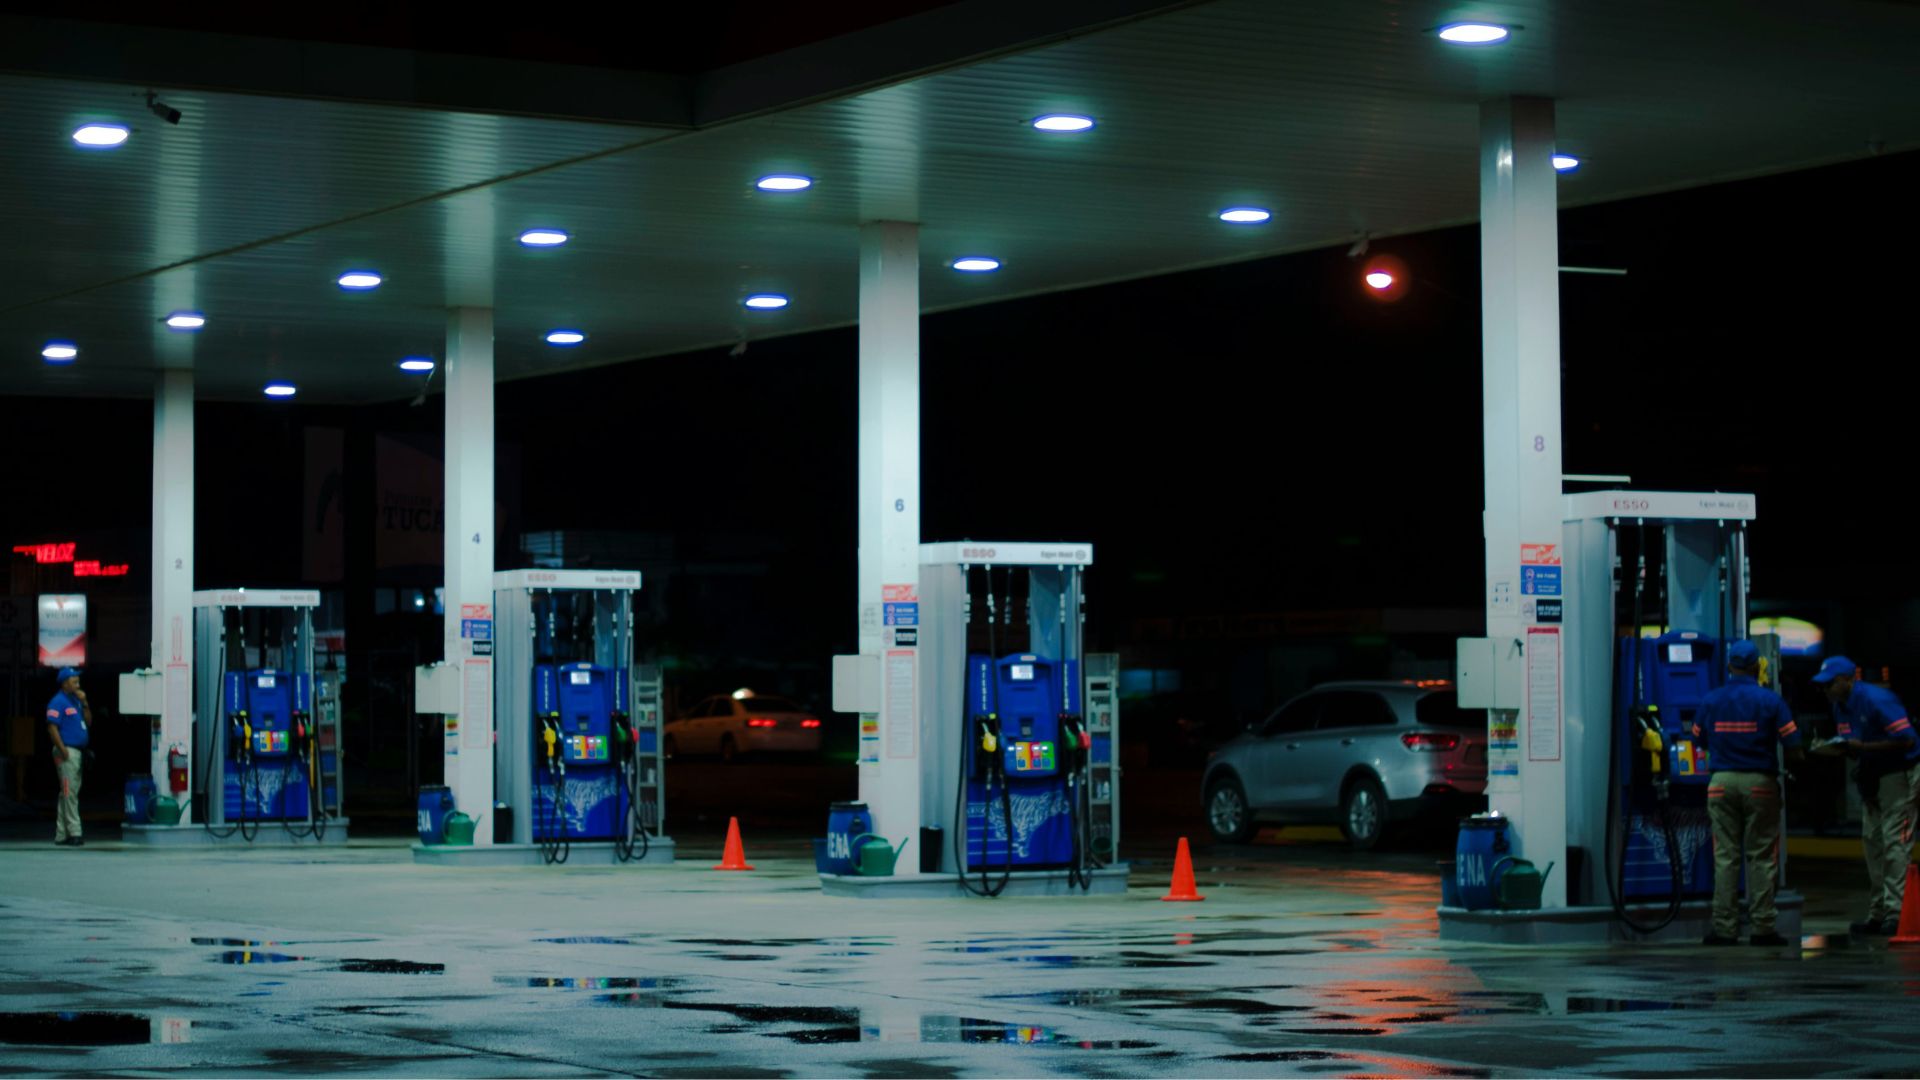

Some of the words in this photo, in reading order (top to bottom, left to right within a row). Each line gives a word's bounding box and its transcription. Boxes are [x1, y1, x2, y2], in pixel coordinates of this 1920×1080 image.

[1534, 435, 1545, 452] 8
[895, 498, 905, 512] 6
[1613, 499, 1649, 510] ESSO
[471, 532, 481, 544] 4
[963, 548, 996, 558] ESSO
[175, 558, 183, 570] 2
